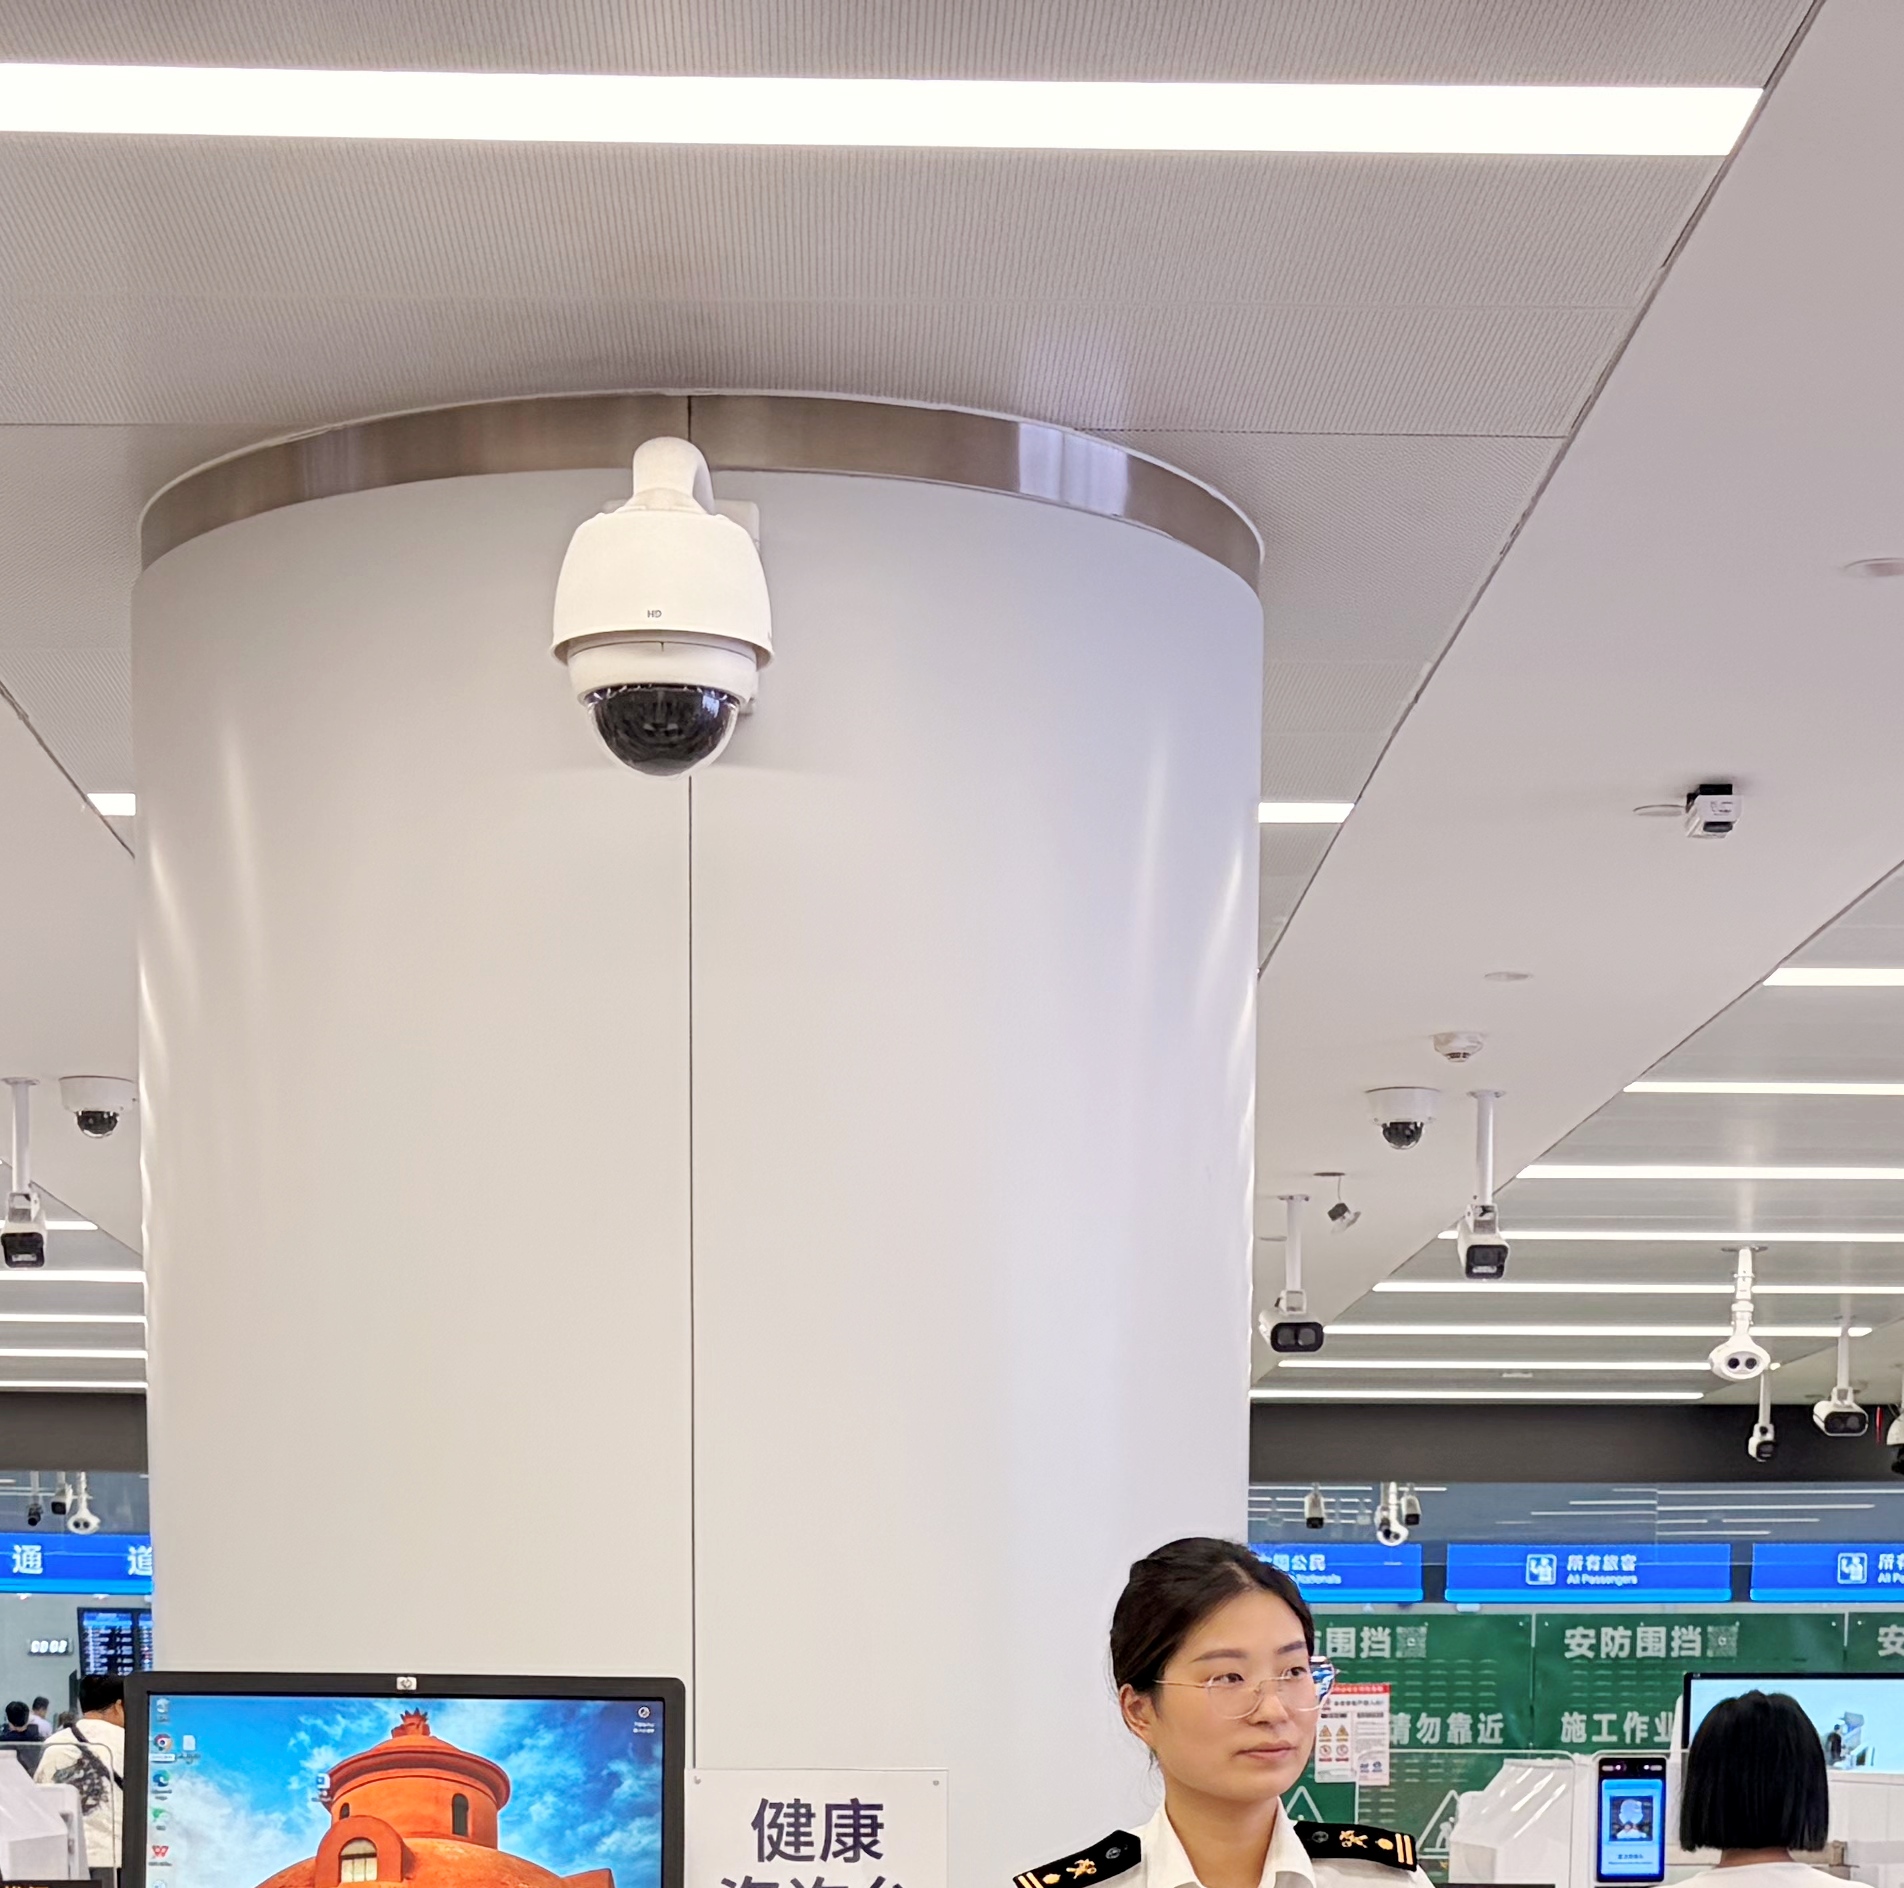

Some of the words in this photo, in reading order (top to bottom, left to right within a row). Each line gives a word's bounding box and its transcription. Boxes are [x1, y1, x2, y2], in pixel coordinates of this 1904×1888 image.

[1567, 1554, 1637, 1571] 所有旅客
[1567, 1574, 1580, 1585] All
[1878, 1573, 1891, 1585] All
[1564, 1626, 1702, 1659] 安防围挡
[1561, 1712, 1675, 1744] 施工作业
[751, 1797, 885, 1864] 健康
